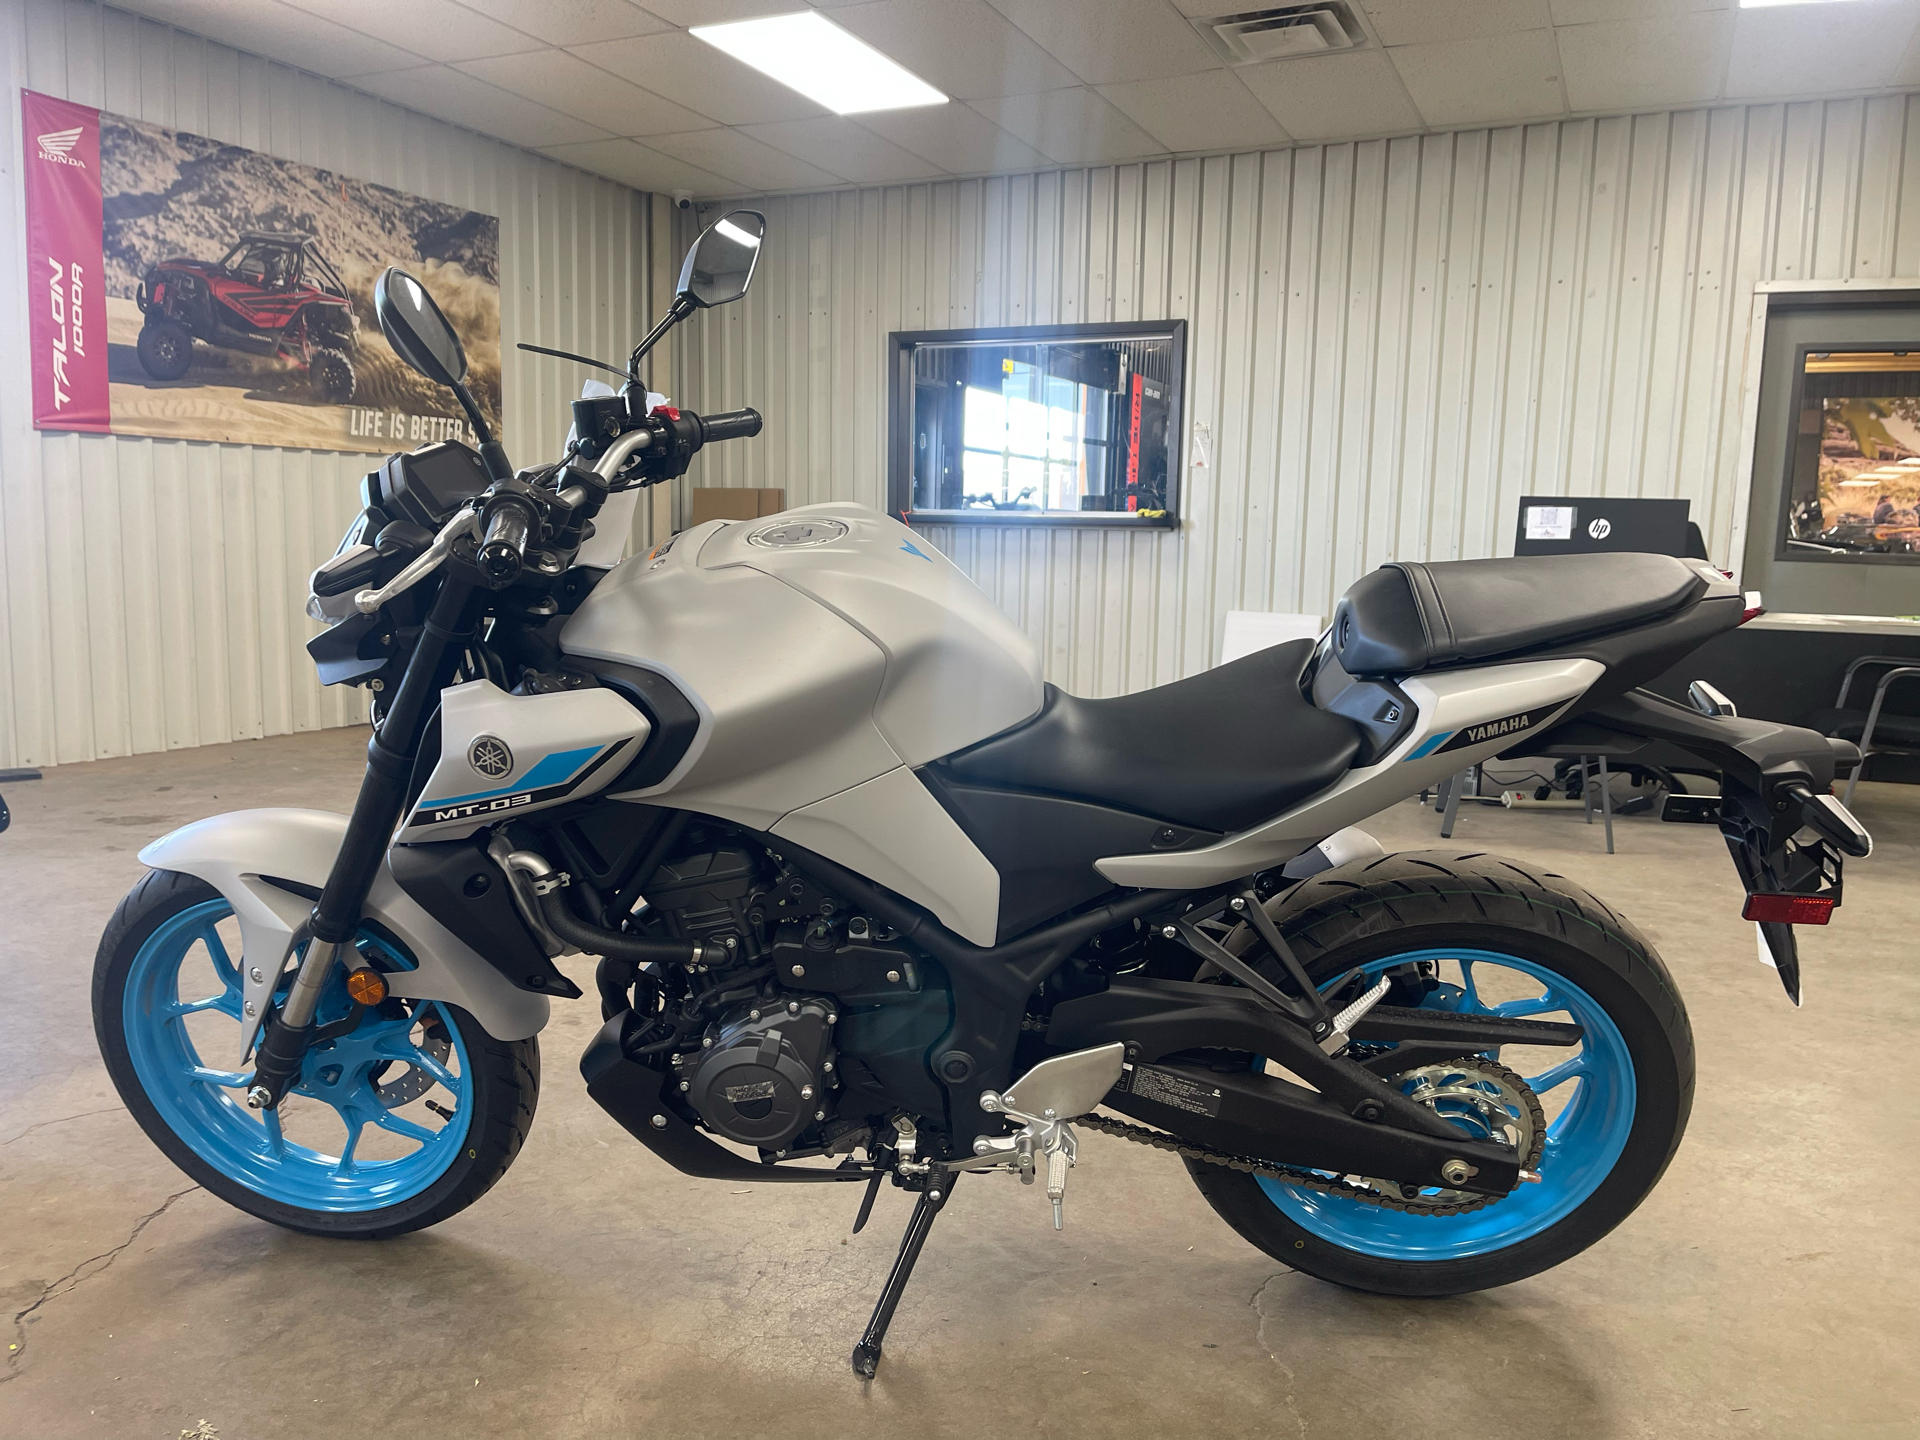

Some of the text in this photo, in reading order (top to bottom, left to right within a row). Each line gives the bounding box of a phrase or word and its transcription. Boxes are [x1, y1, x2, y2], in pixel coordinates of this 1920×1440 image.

[38, 150, 86, 169] HONDA
[71, 262, 85, 358] 1000R
[49, 256, 71, 412] TALON
[350, 409, 384, 438] LIFE
[390, 413, 405, 439] IS
[410, 414, 463, 443] BETTER
[1590, 518, 1609, 540] hp
[1467, 714, 1530, 742] YAMAHA
[435, 793, 532, 821] MT-03
